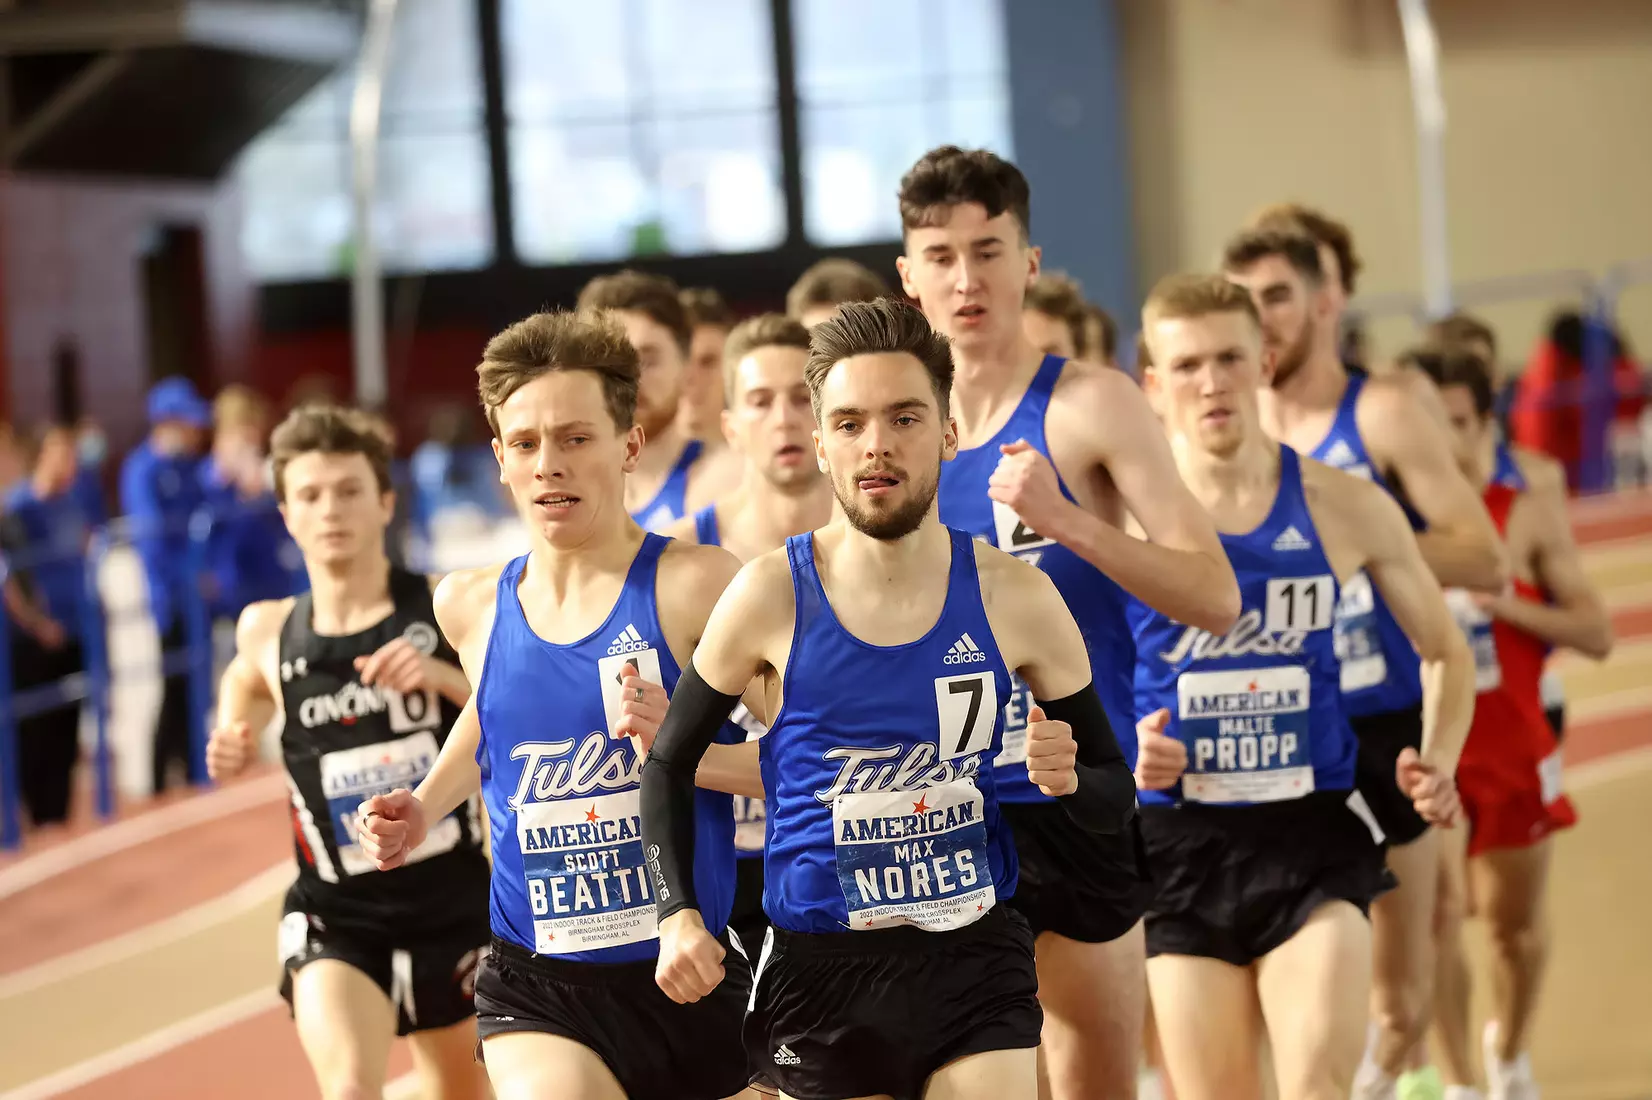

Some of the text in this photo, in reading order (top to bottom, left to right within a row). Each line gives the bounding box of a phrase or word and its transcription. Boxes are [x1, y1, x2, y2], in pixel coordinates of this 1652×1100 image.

[1280, 582, 1318, 628] 11
[607, 638, 650, 656] adidas
[943, 650, 986, 665] adidas
[1187, 688, 1301, 714] AMERICAN
[947, 677, 983, 754] 7
[1218, 716, 1275, 736] MALTE
[1194, 732, 1298, 771] PROPP
[841, 800, 975, 842] AMERICAN
[563, 848, 620, 873] SCOTT
[894, 839, 935, 863] MAX
[855, 848, 978, 903] NORES
[921, 902, 939, 911] FIELD
[940, 890, 987, 908] CHAMPIONSHIPS
[926, 907, 961, 918] CROSSPLEX
[553, 919, 576, 929] INDOOR
[576, 916, 596, 926] TRACK
[601, 913, 618, 923] FIELD
[567, 919, 641, 937] BIRMINGHAM CROSSPLEX
